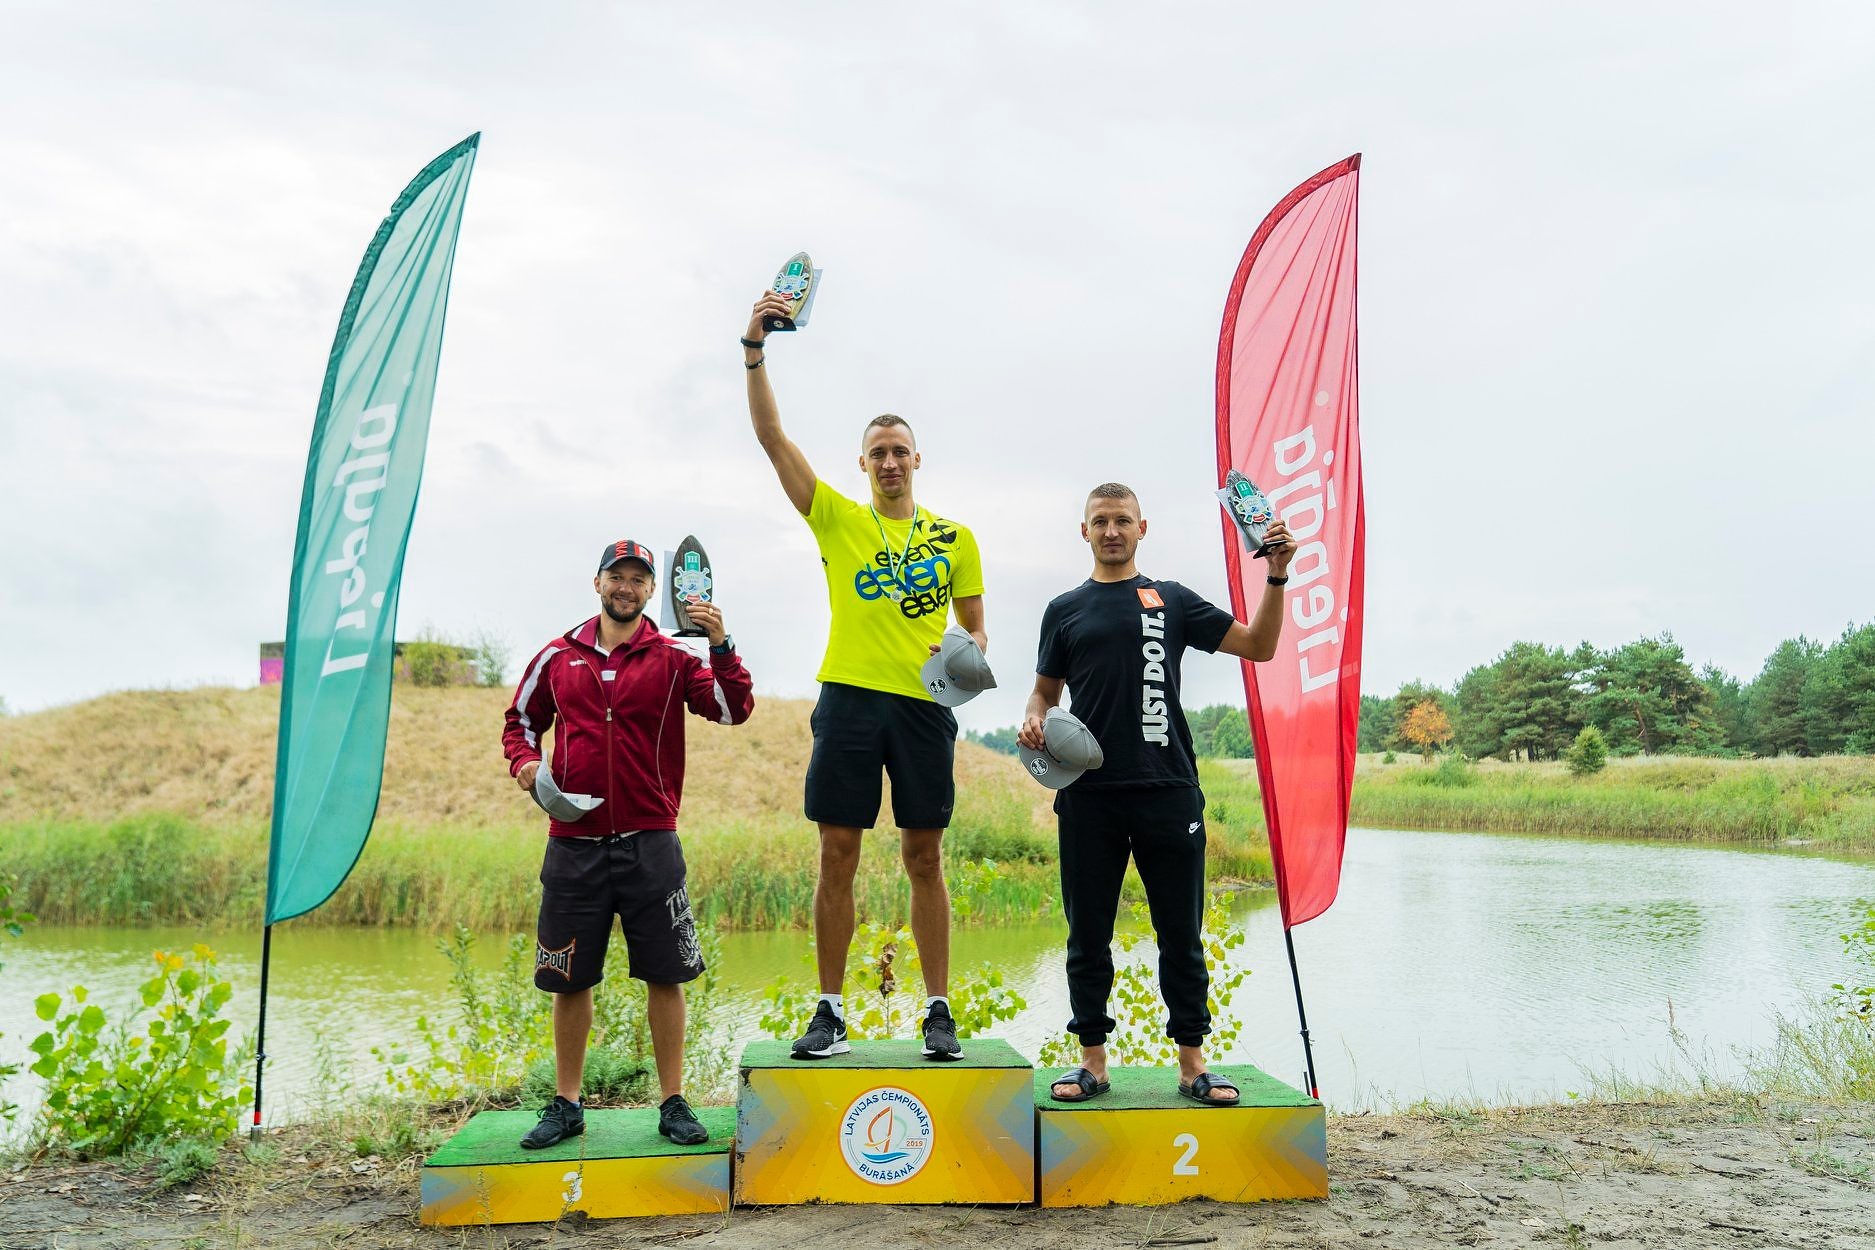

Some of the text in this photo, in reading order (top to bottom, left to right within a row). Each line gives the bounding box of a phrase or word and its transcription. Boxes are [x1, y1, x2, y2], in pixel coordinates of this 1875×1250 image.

[1141, 612, 1170, 747] JUST DO IT.
[845, 1091, 930, 1136] LATVIJAS ČEMPIONĀTS
[859, 1163, 915, 1181] BURĀŠANĀ
[1173, 1133, 1199, 1176] 2
[562, 1171, 583, 1203] 3
